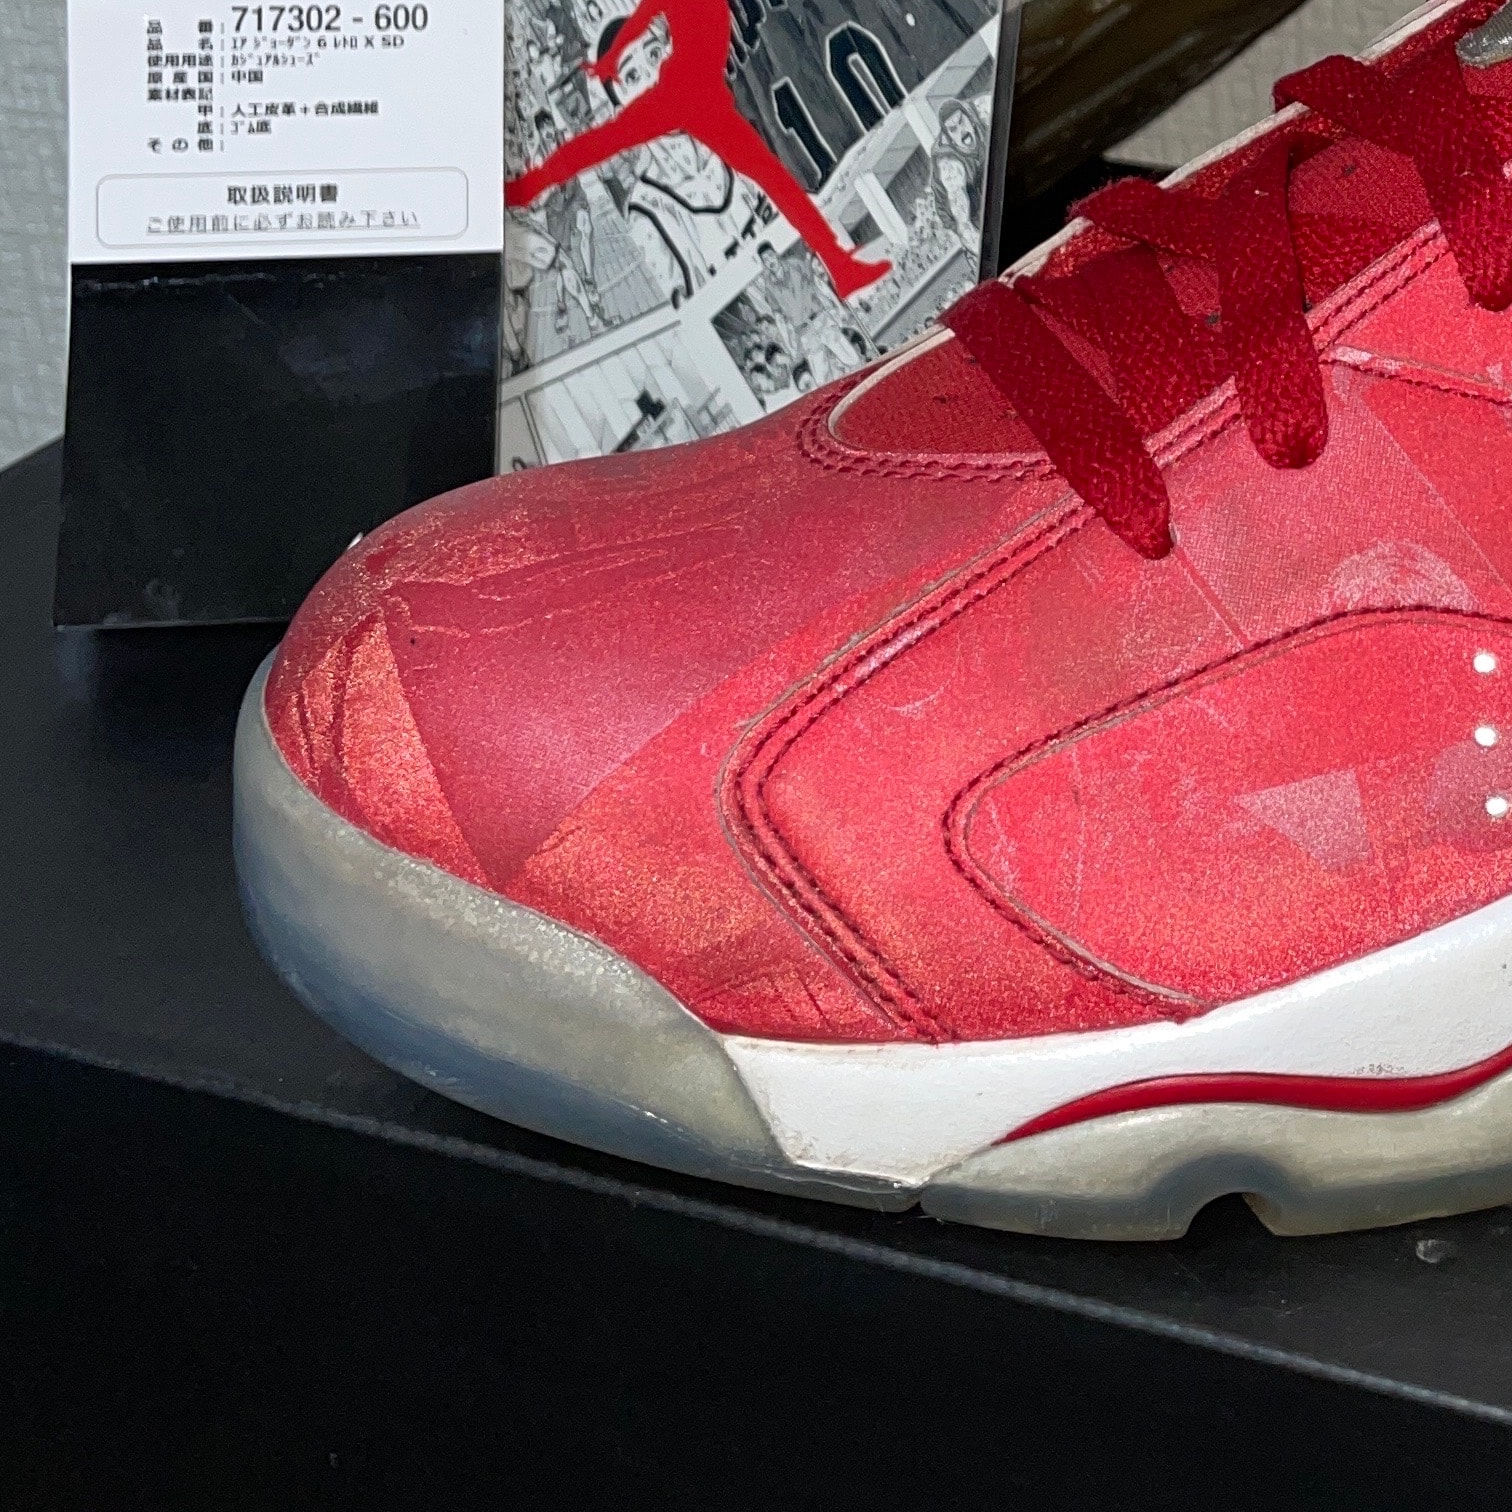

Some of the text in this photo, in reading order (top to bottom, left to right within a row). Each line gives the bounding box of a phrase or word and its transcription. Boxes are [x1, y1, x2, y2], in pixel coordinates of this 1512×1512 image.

[231, 4, 342, 33] 717302
[374, 3, 429, 32] 600
[231, 69, 263, 85] 中国
[227, 182, 339, 206] 取扱説明書
